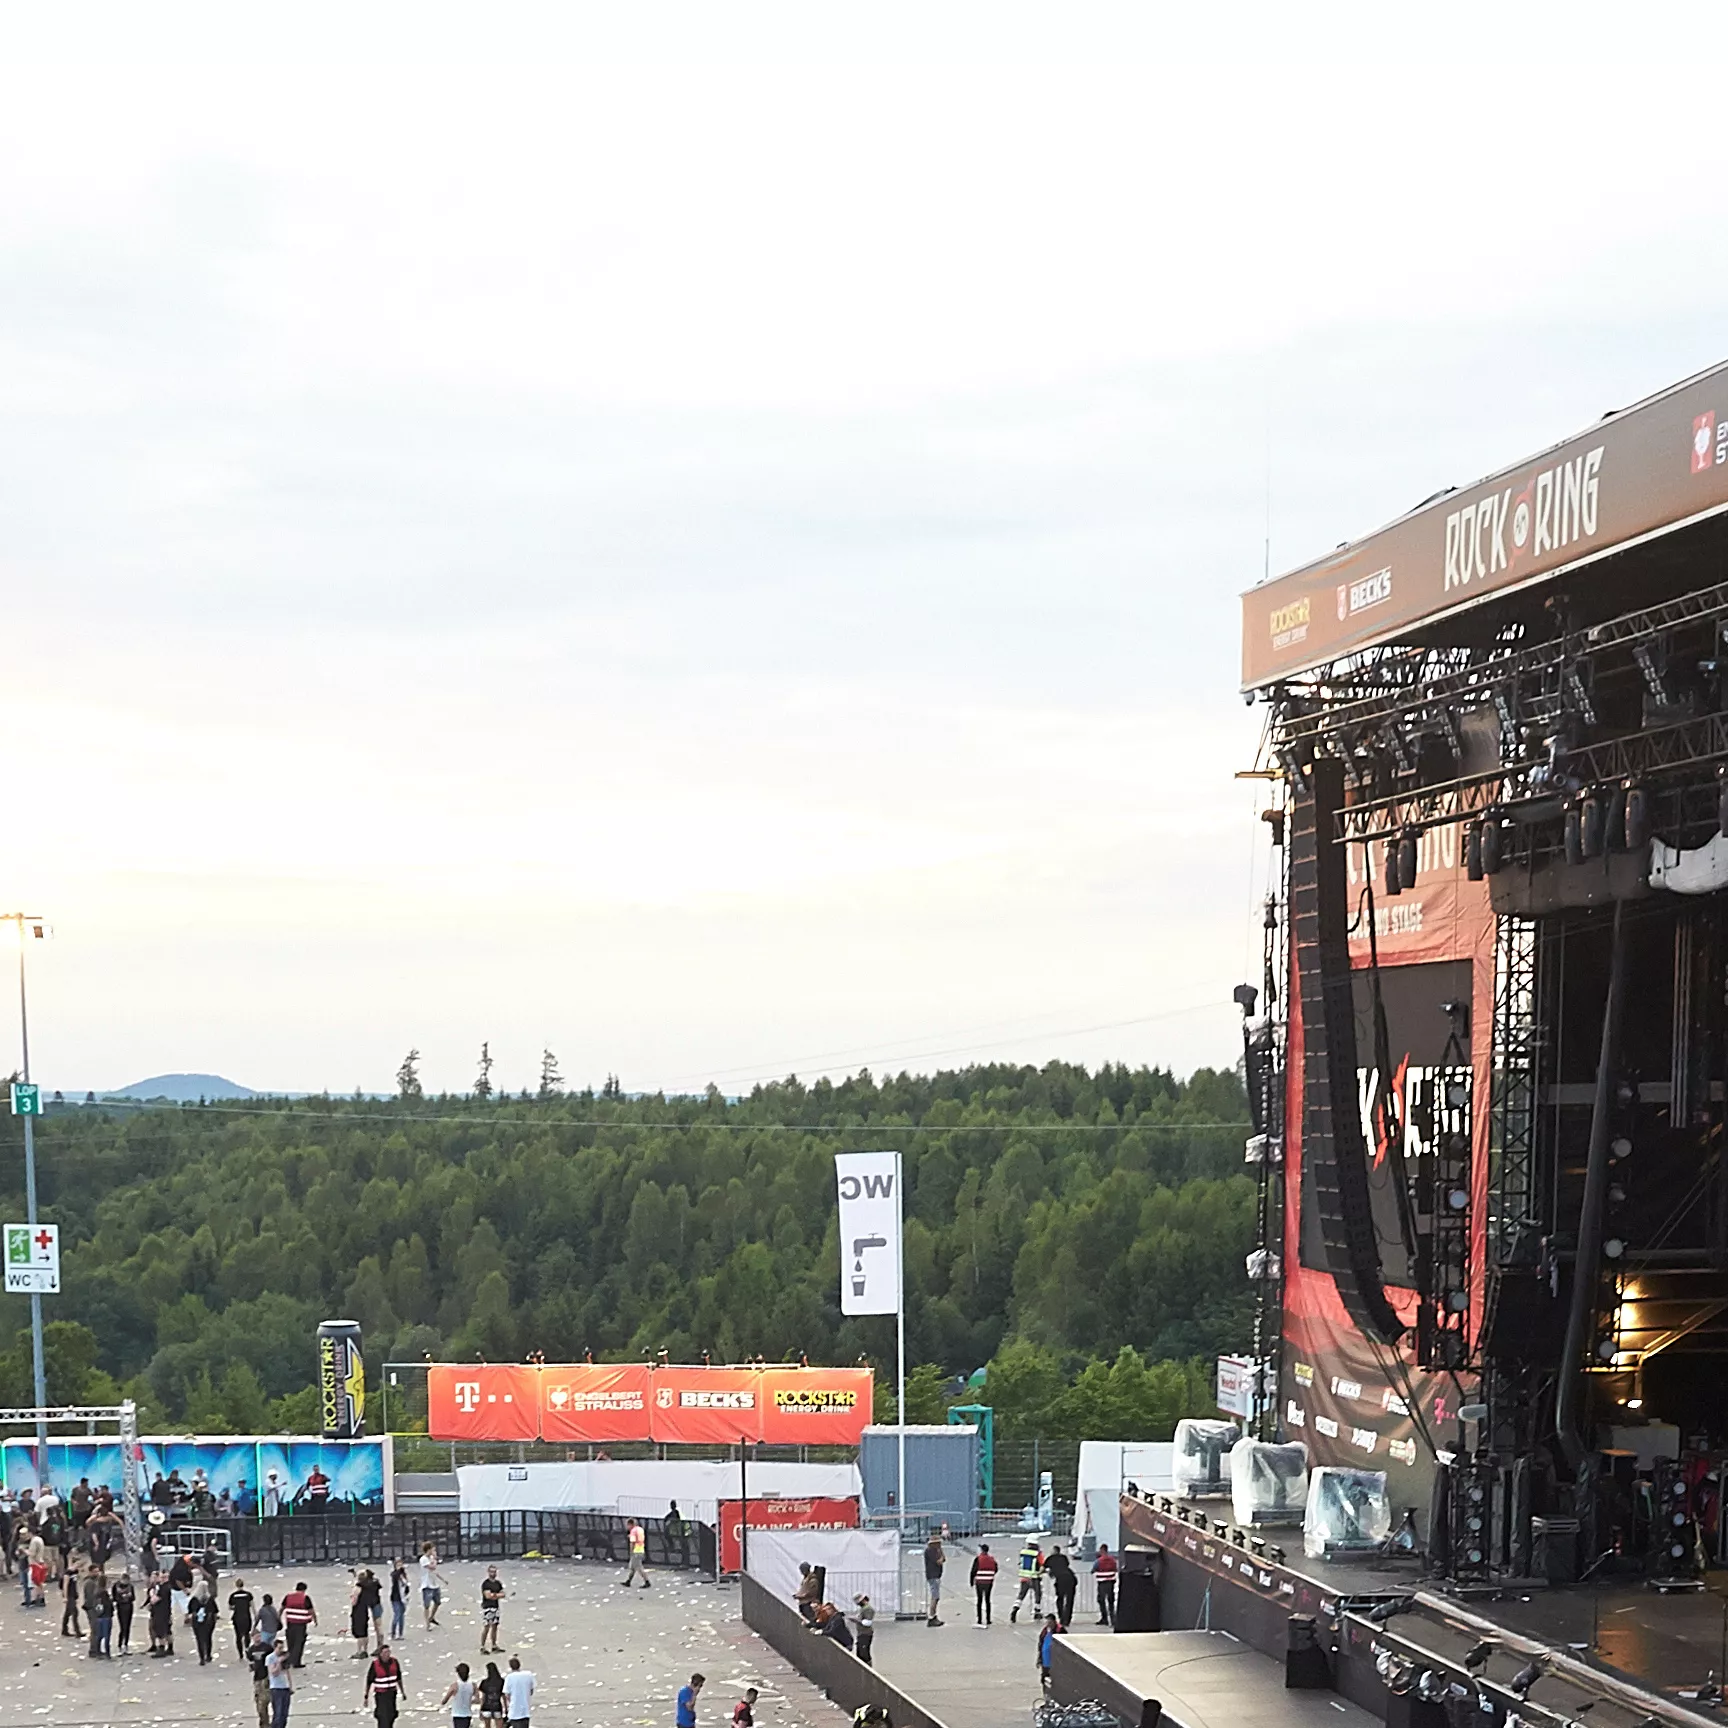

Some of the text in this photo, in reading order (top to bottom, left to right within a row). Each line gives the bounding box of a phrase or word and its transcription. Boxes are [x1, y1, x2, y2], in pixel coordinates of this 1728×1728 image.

[1444, 487, 1512, 592] ROCK
[1534, 446, 1605, 557] RING
[22, 1097, 32, 1112] 3
[8, 1274, 32, 1287] WC
[573, 1391, 643, 1401] ENGELBERT
[680, 1391, 755, 1409] BECK'S
[574, 1400, 644, 1411] STRAUSS
[780, 1405, 851, 1413] ENERGY DRINK
